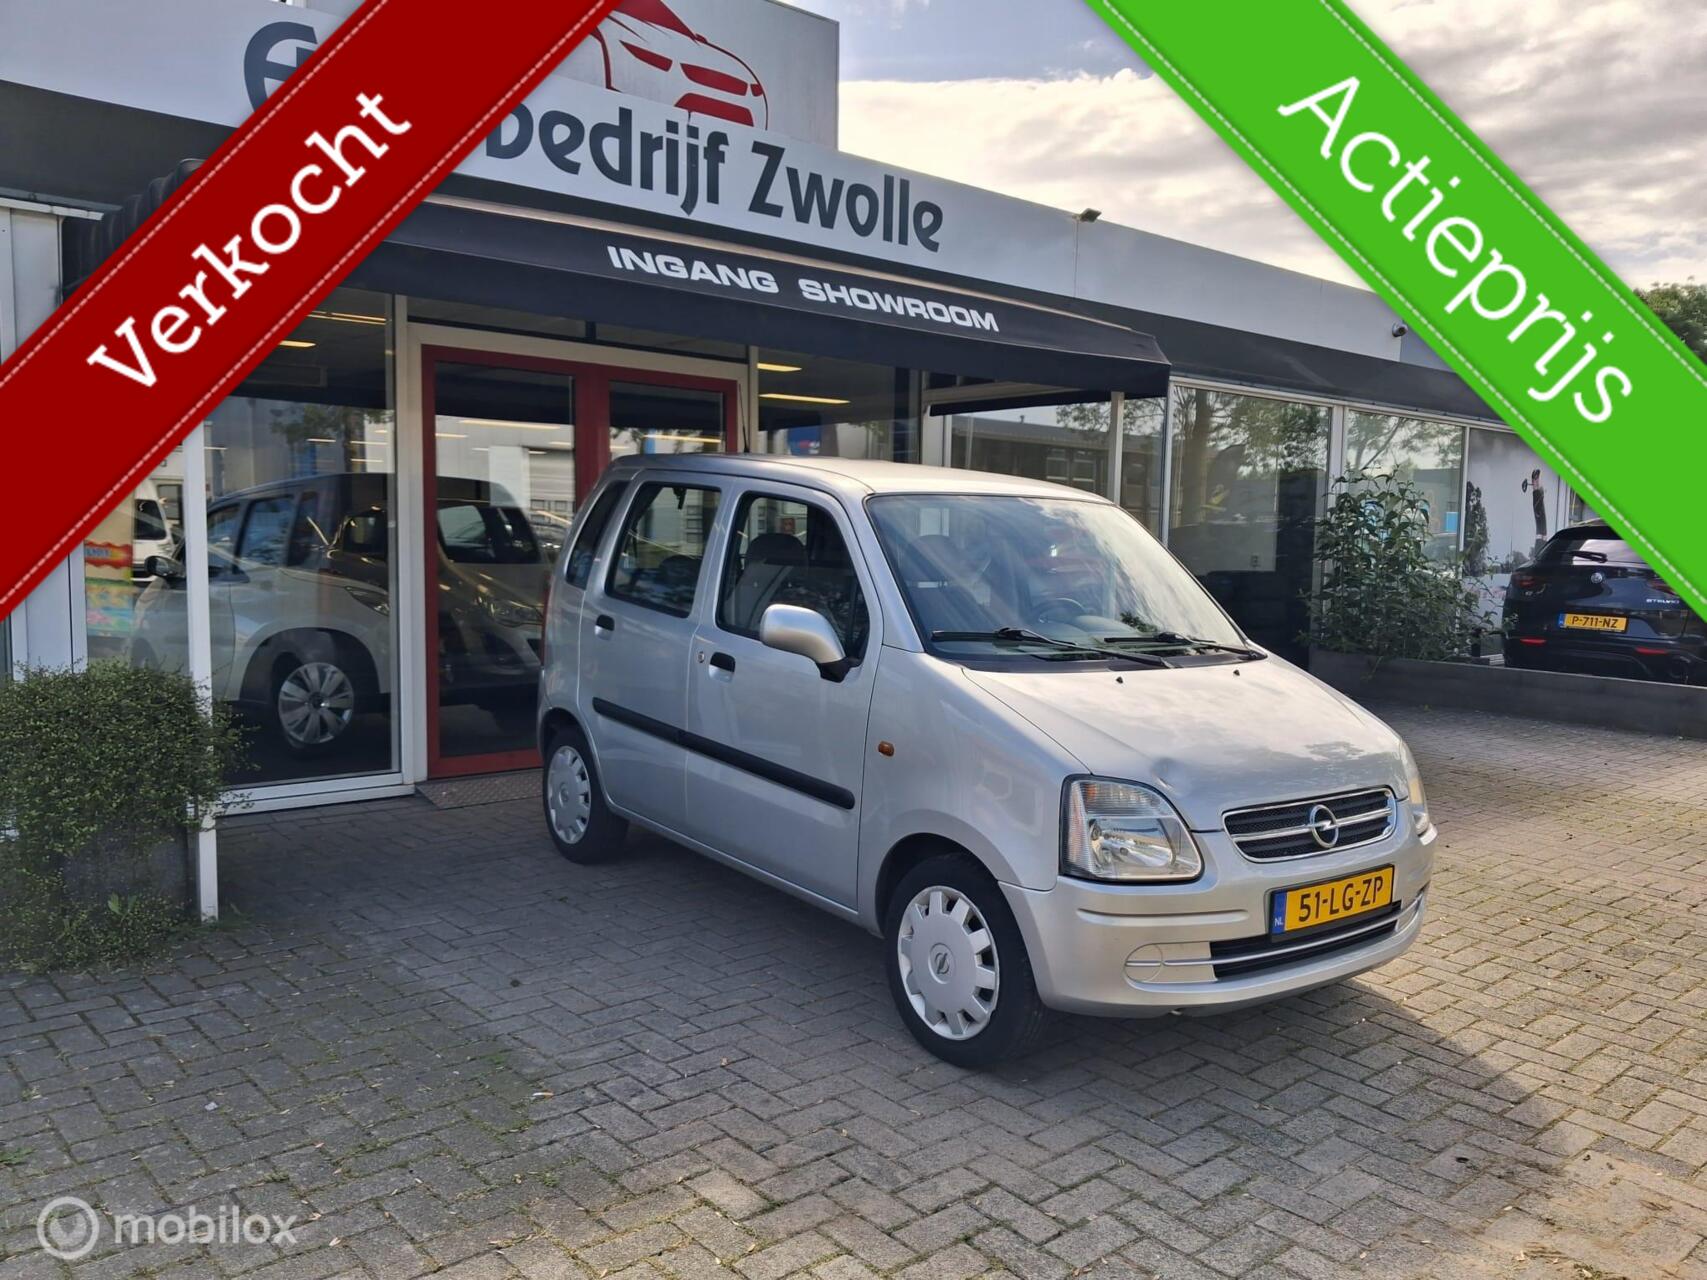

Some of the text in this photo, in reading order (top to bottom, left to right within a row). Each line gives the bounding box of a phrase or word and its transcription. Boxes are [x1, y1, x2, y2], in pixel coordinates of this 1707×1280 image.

[748, 140, 943, 253] Zwolle
[607, 245, 999, 332] INGANG SHOWROOM
[1571, 615, 1619, 628] P-711-NZ
[1274, 916, 1284, 927] NL
[1298, 876, 1383, 922] 51-LG-ZP
